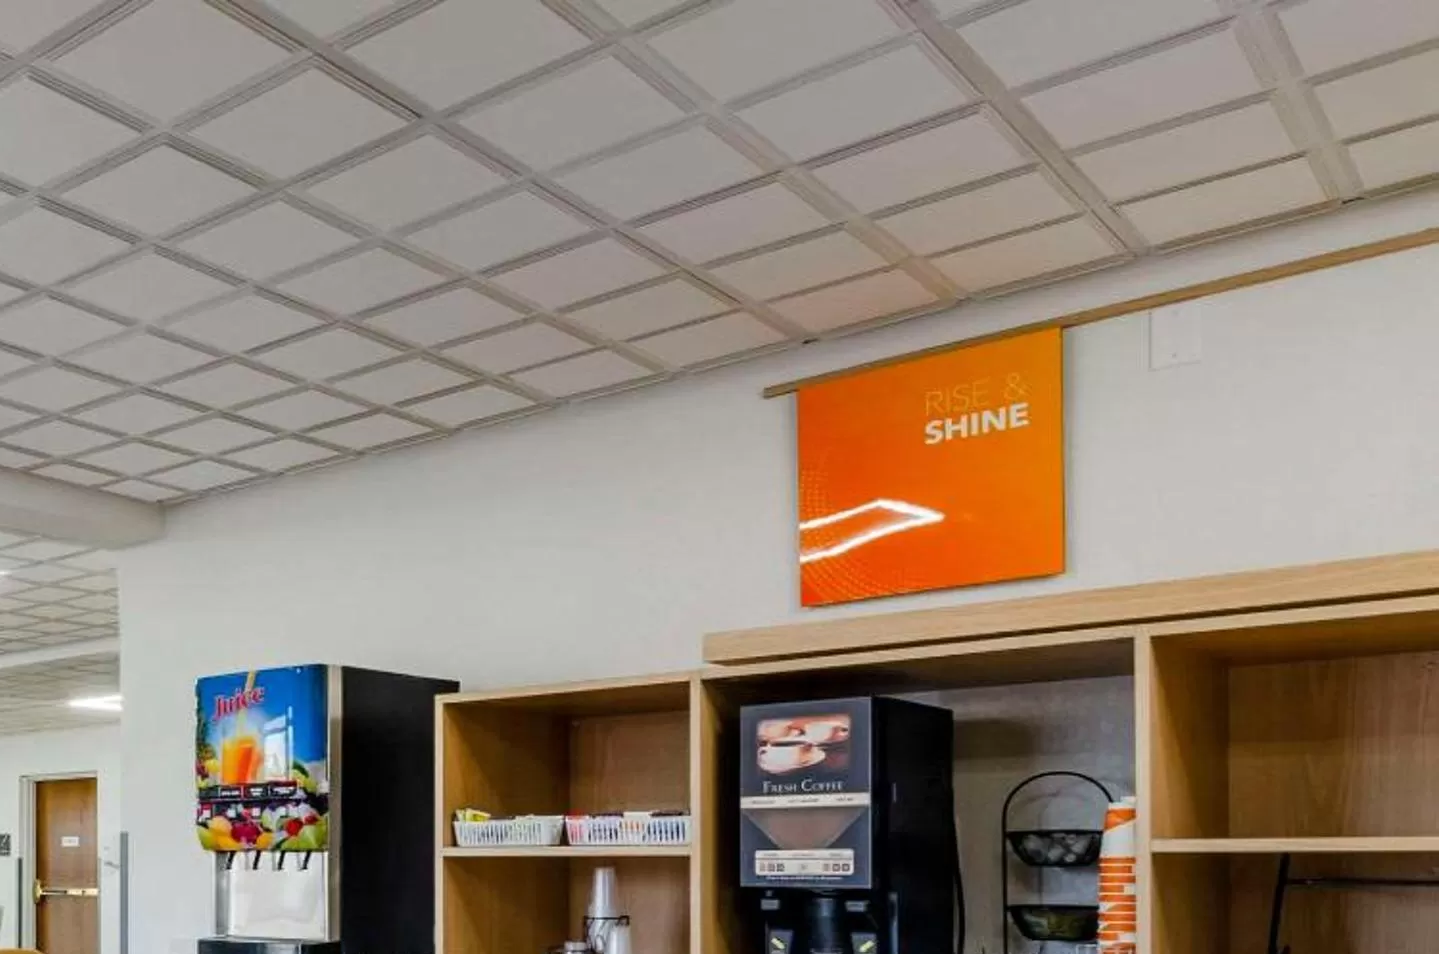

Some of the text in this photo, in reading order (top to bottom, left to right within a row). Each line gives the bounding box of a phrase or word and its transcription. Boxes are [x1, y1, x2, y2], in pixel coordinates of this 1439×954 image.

[924, 372, 1032, 417] RISE &
[924, 402, 1030, 445] SHINE
[214, 686, 265, 722] Juice
